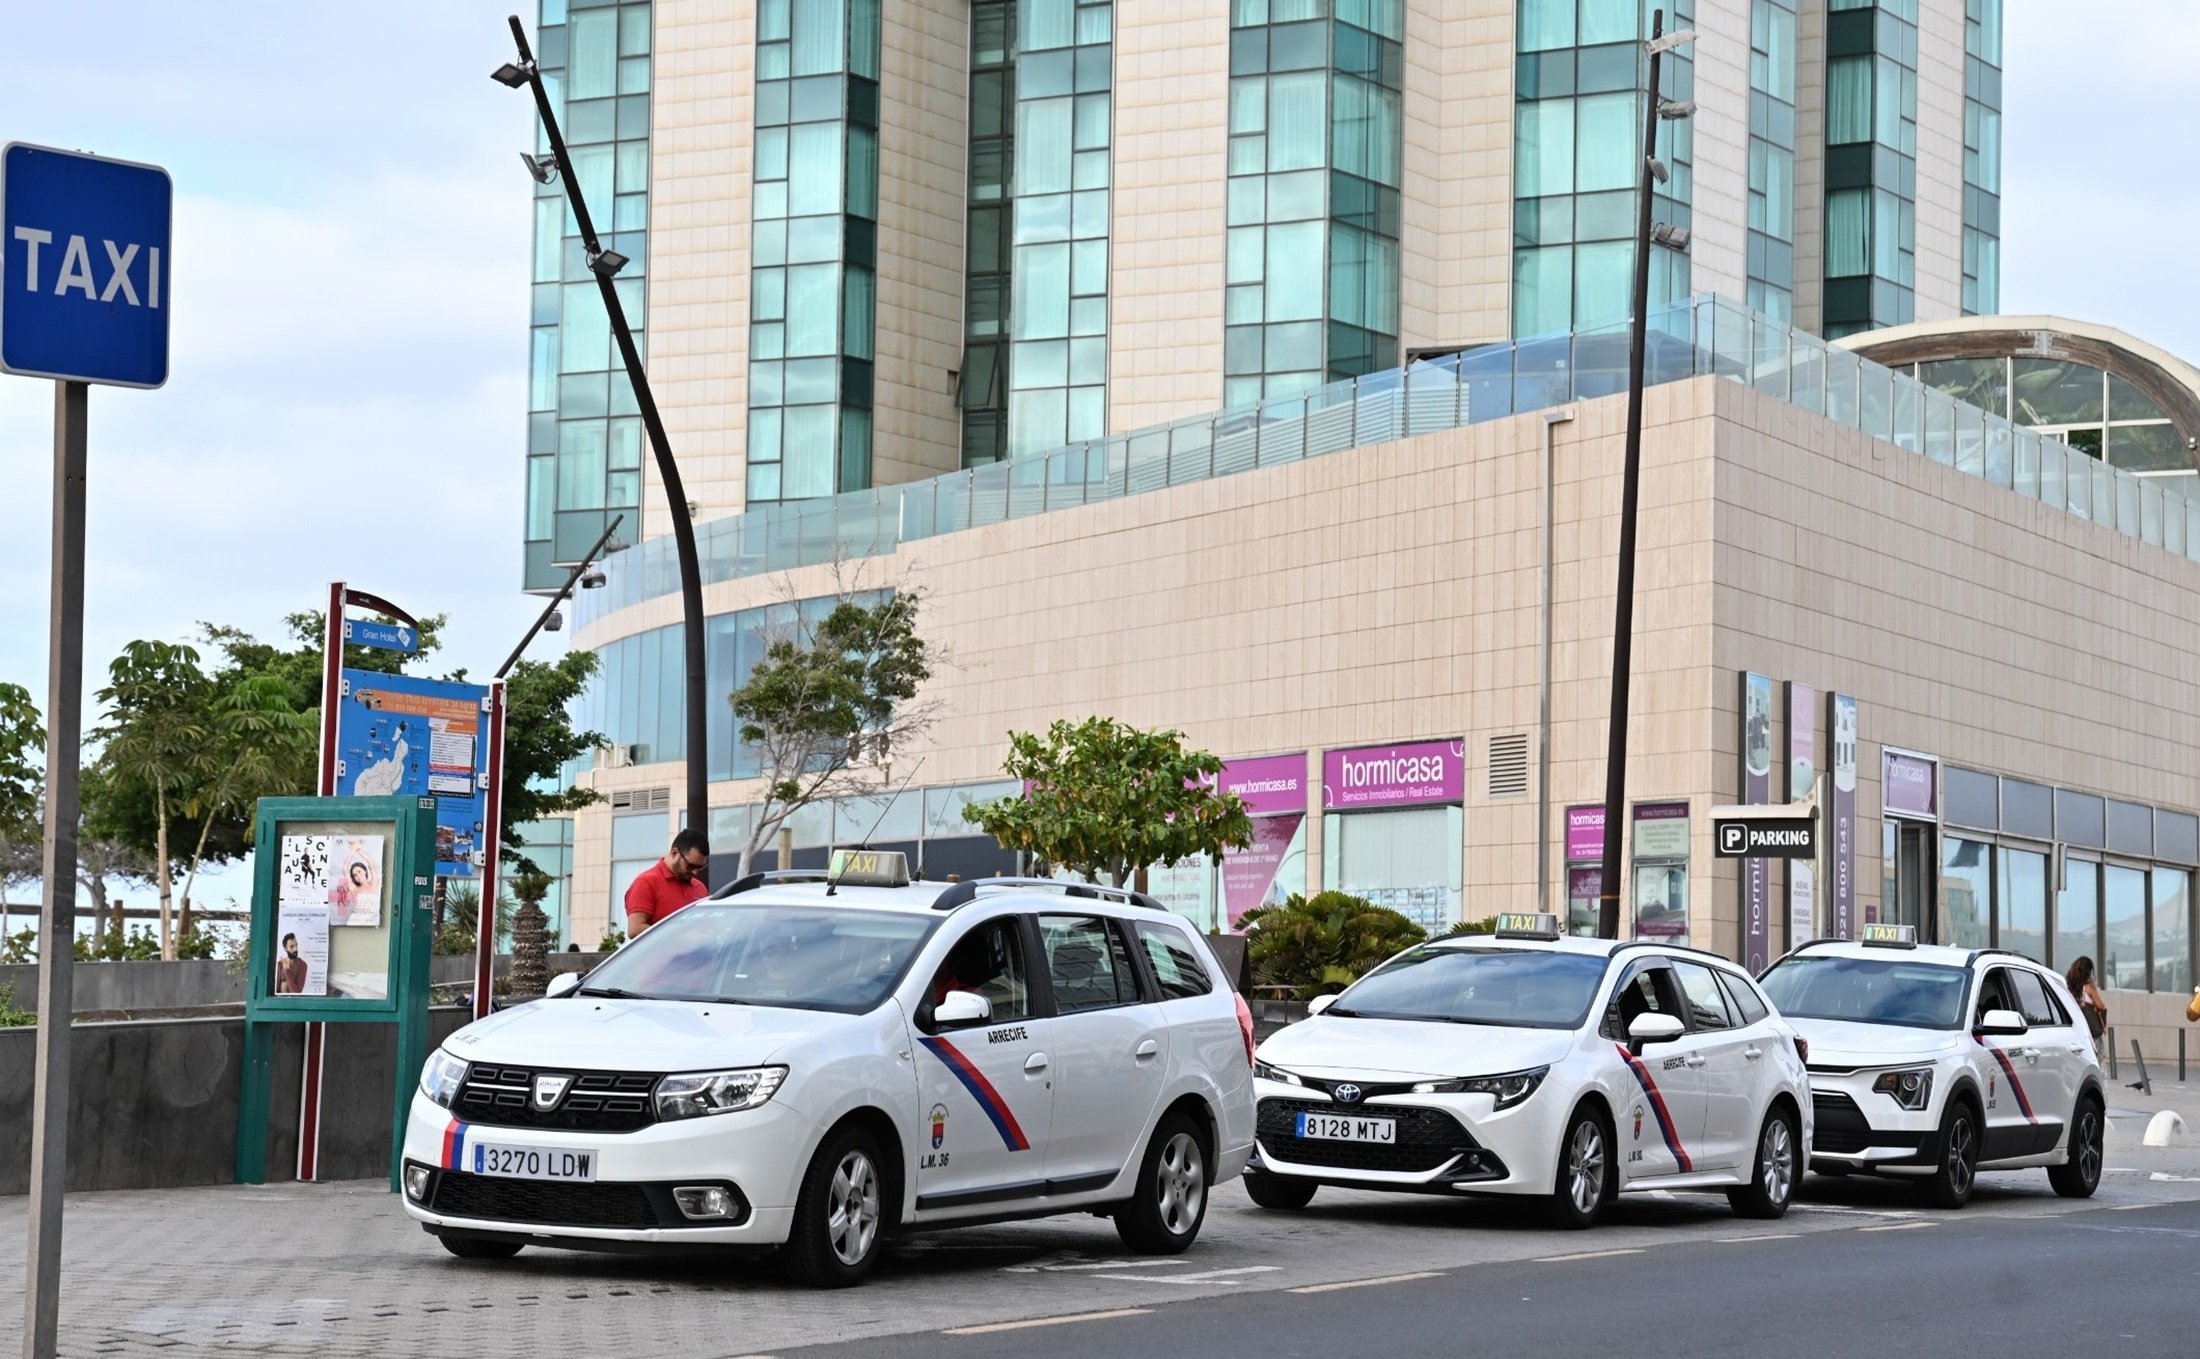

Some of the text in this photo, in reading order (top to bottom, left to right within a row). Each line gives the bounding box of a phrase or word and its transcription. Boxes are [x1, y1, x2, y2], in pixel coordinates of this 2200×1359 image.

[14, 225, 160, 309] TAXI
[362, 628, 398, 642] Gran Hotel
[1342, 750, 1443, 788] hormicasa
[1228, 777, 1298, 794] www.hormicasa.es
[1342, 790, 1368, 802] Servicios
[1409, 786, 1422, 798] Real
[1424, 785, 1443, 797] Estate
[1570, 812, 1605, 826] hormicas
[1750, 830, 1810, 846] PARKING
[845, 854, 878, 873] TAXI
[1509, 915, 1536, 930] TAXI
[1873, 927, 1897, 940] TAXI
[988, 1027, 1028, 1045] ARRECIFE
[1307, 1118, 1350, 1138] 8128
[1357, 1121, 1391, 1141] MTJ
[488, 1149, 540, 1175] 3270
[548, 1152, 590, 1178] LDW
[920, 1152, 950, 1169] L.M. 36
